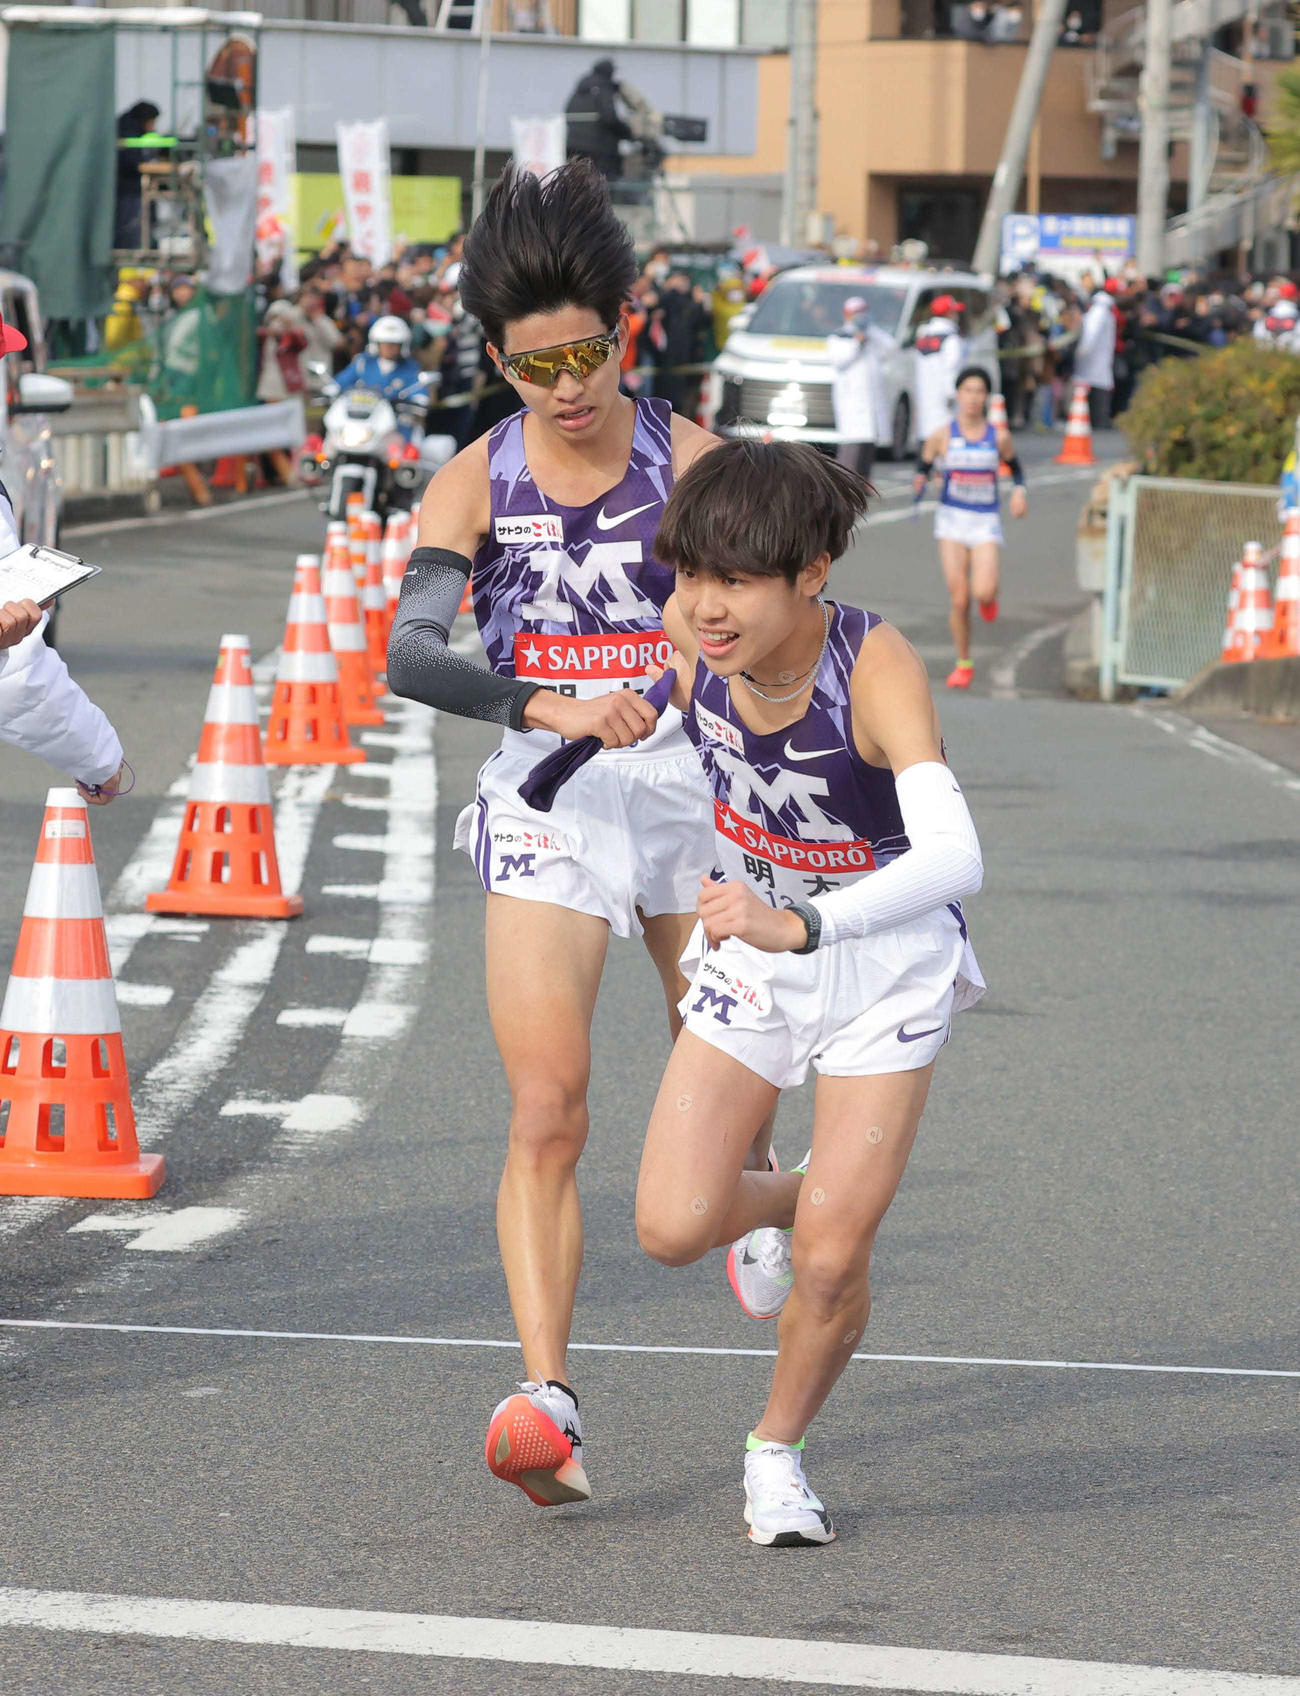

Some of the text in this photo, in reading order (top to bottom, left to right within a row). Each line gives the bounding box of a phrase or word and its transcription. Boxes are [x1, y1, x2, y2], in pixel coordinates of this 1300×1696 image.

[521, 539, 660, 623] M
[547, 640, 674, 671] SAPPORO
[711, 749, 855, 843] M
[495, 853, 536, 882] M
[742, 826, 868, 868] SAPPORO
[691, 985, 739, 1027] M
